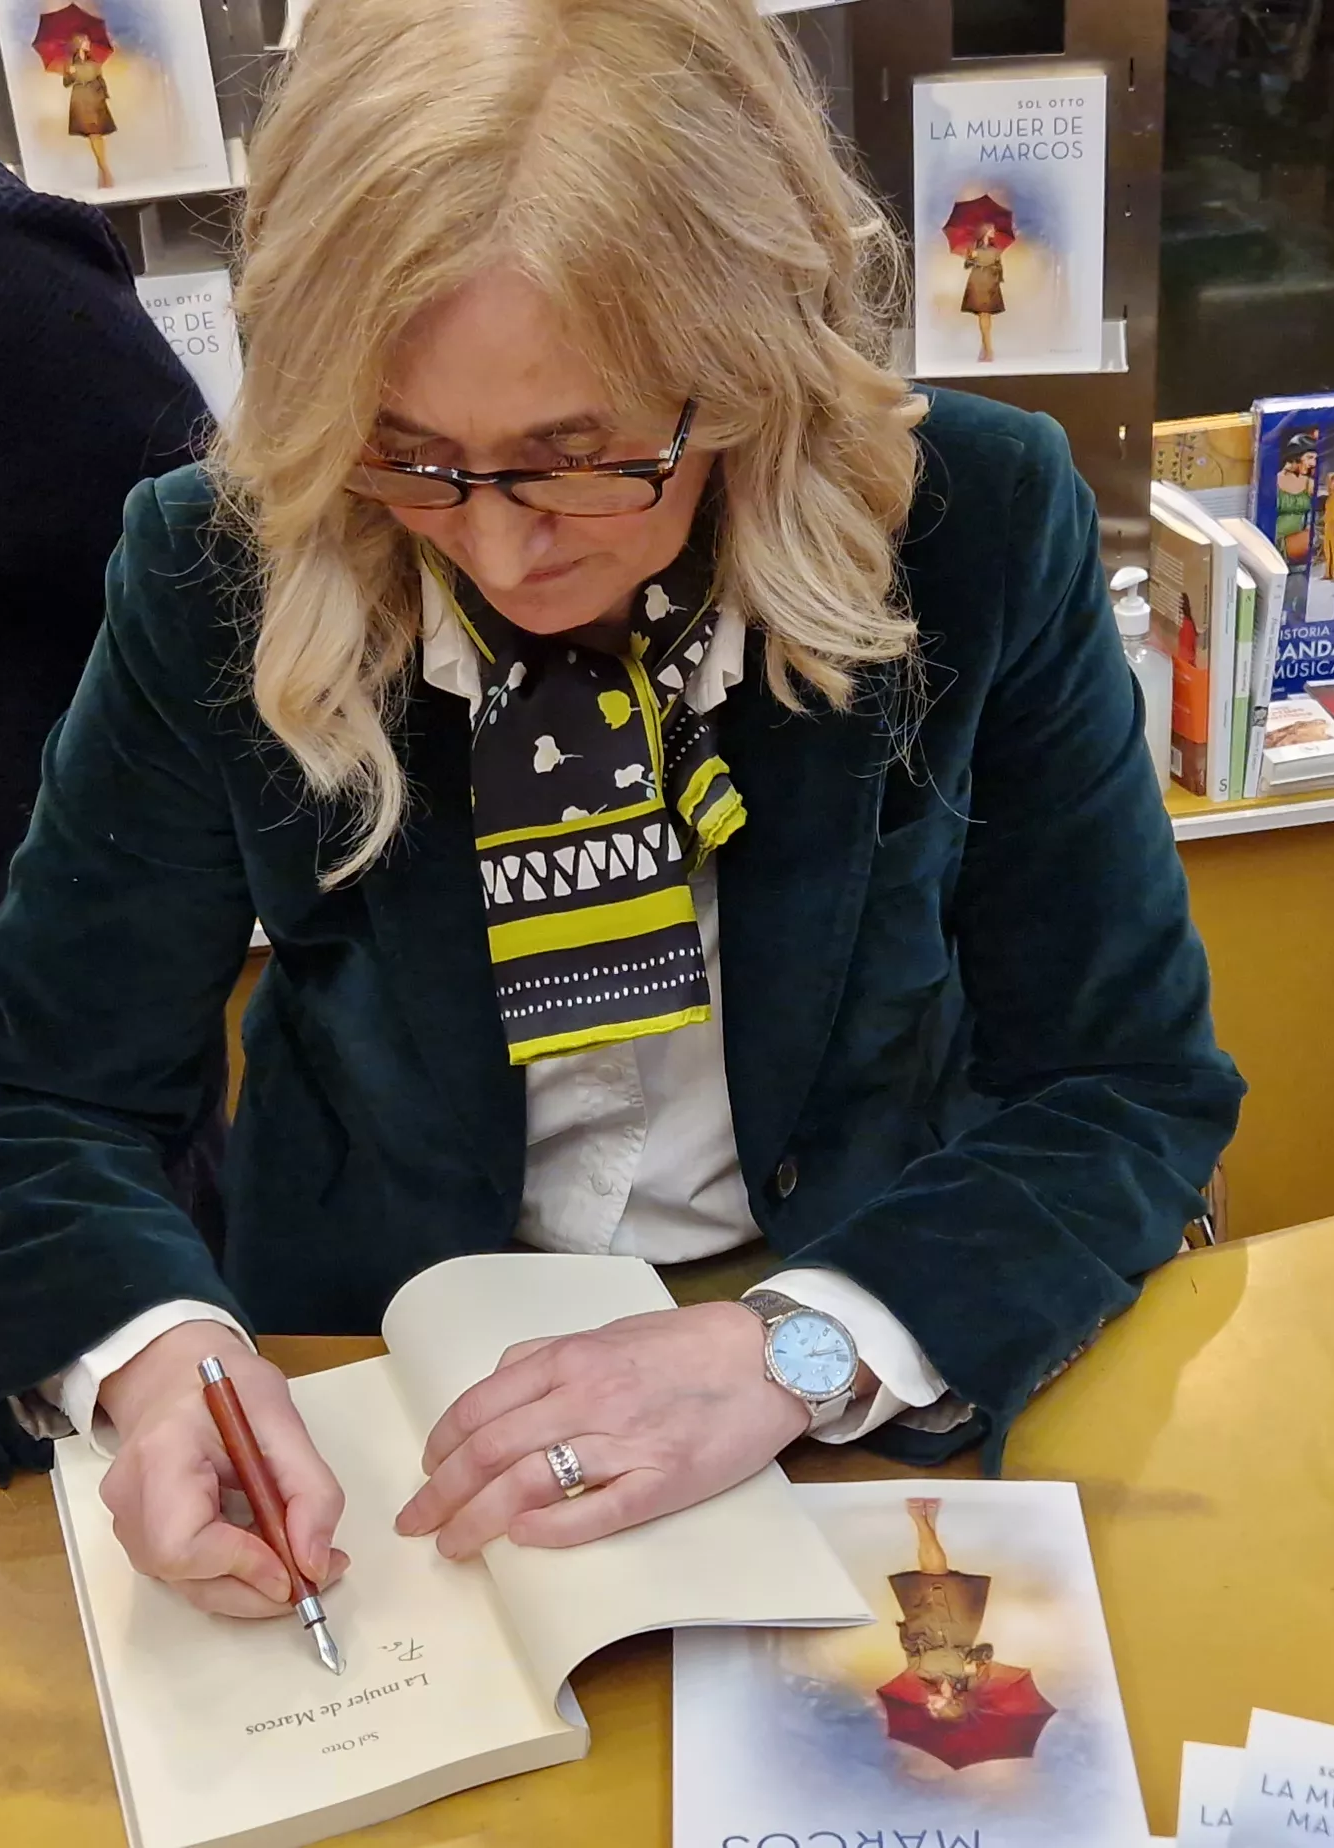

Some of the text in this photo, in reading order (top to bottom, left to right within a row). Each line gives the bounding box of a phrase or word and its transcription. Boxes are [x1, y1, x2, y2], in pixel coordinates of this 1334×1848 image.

[1017, 98, 1085, 110] SOL OTTO
[930, 116, 1084, 140] LA MUJER DE
[979, 141, 1084, 163] MARCOS
[146, 293, 212, 308] SOL OTTO
[185, 311, 216, 331] DE
[169, 335, 219, 356] COS
[1280, 625, 1330, 641] ISTORIA
[245, 1672, 429, 1735] La mujer de Marcos
[321, 1732, 380, 1754] Sol Otto
[1261, 1773, 1295, 1801] LA
[1199, 1804, 1235, 1828] LA
